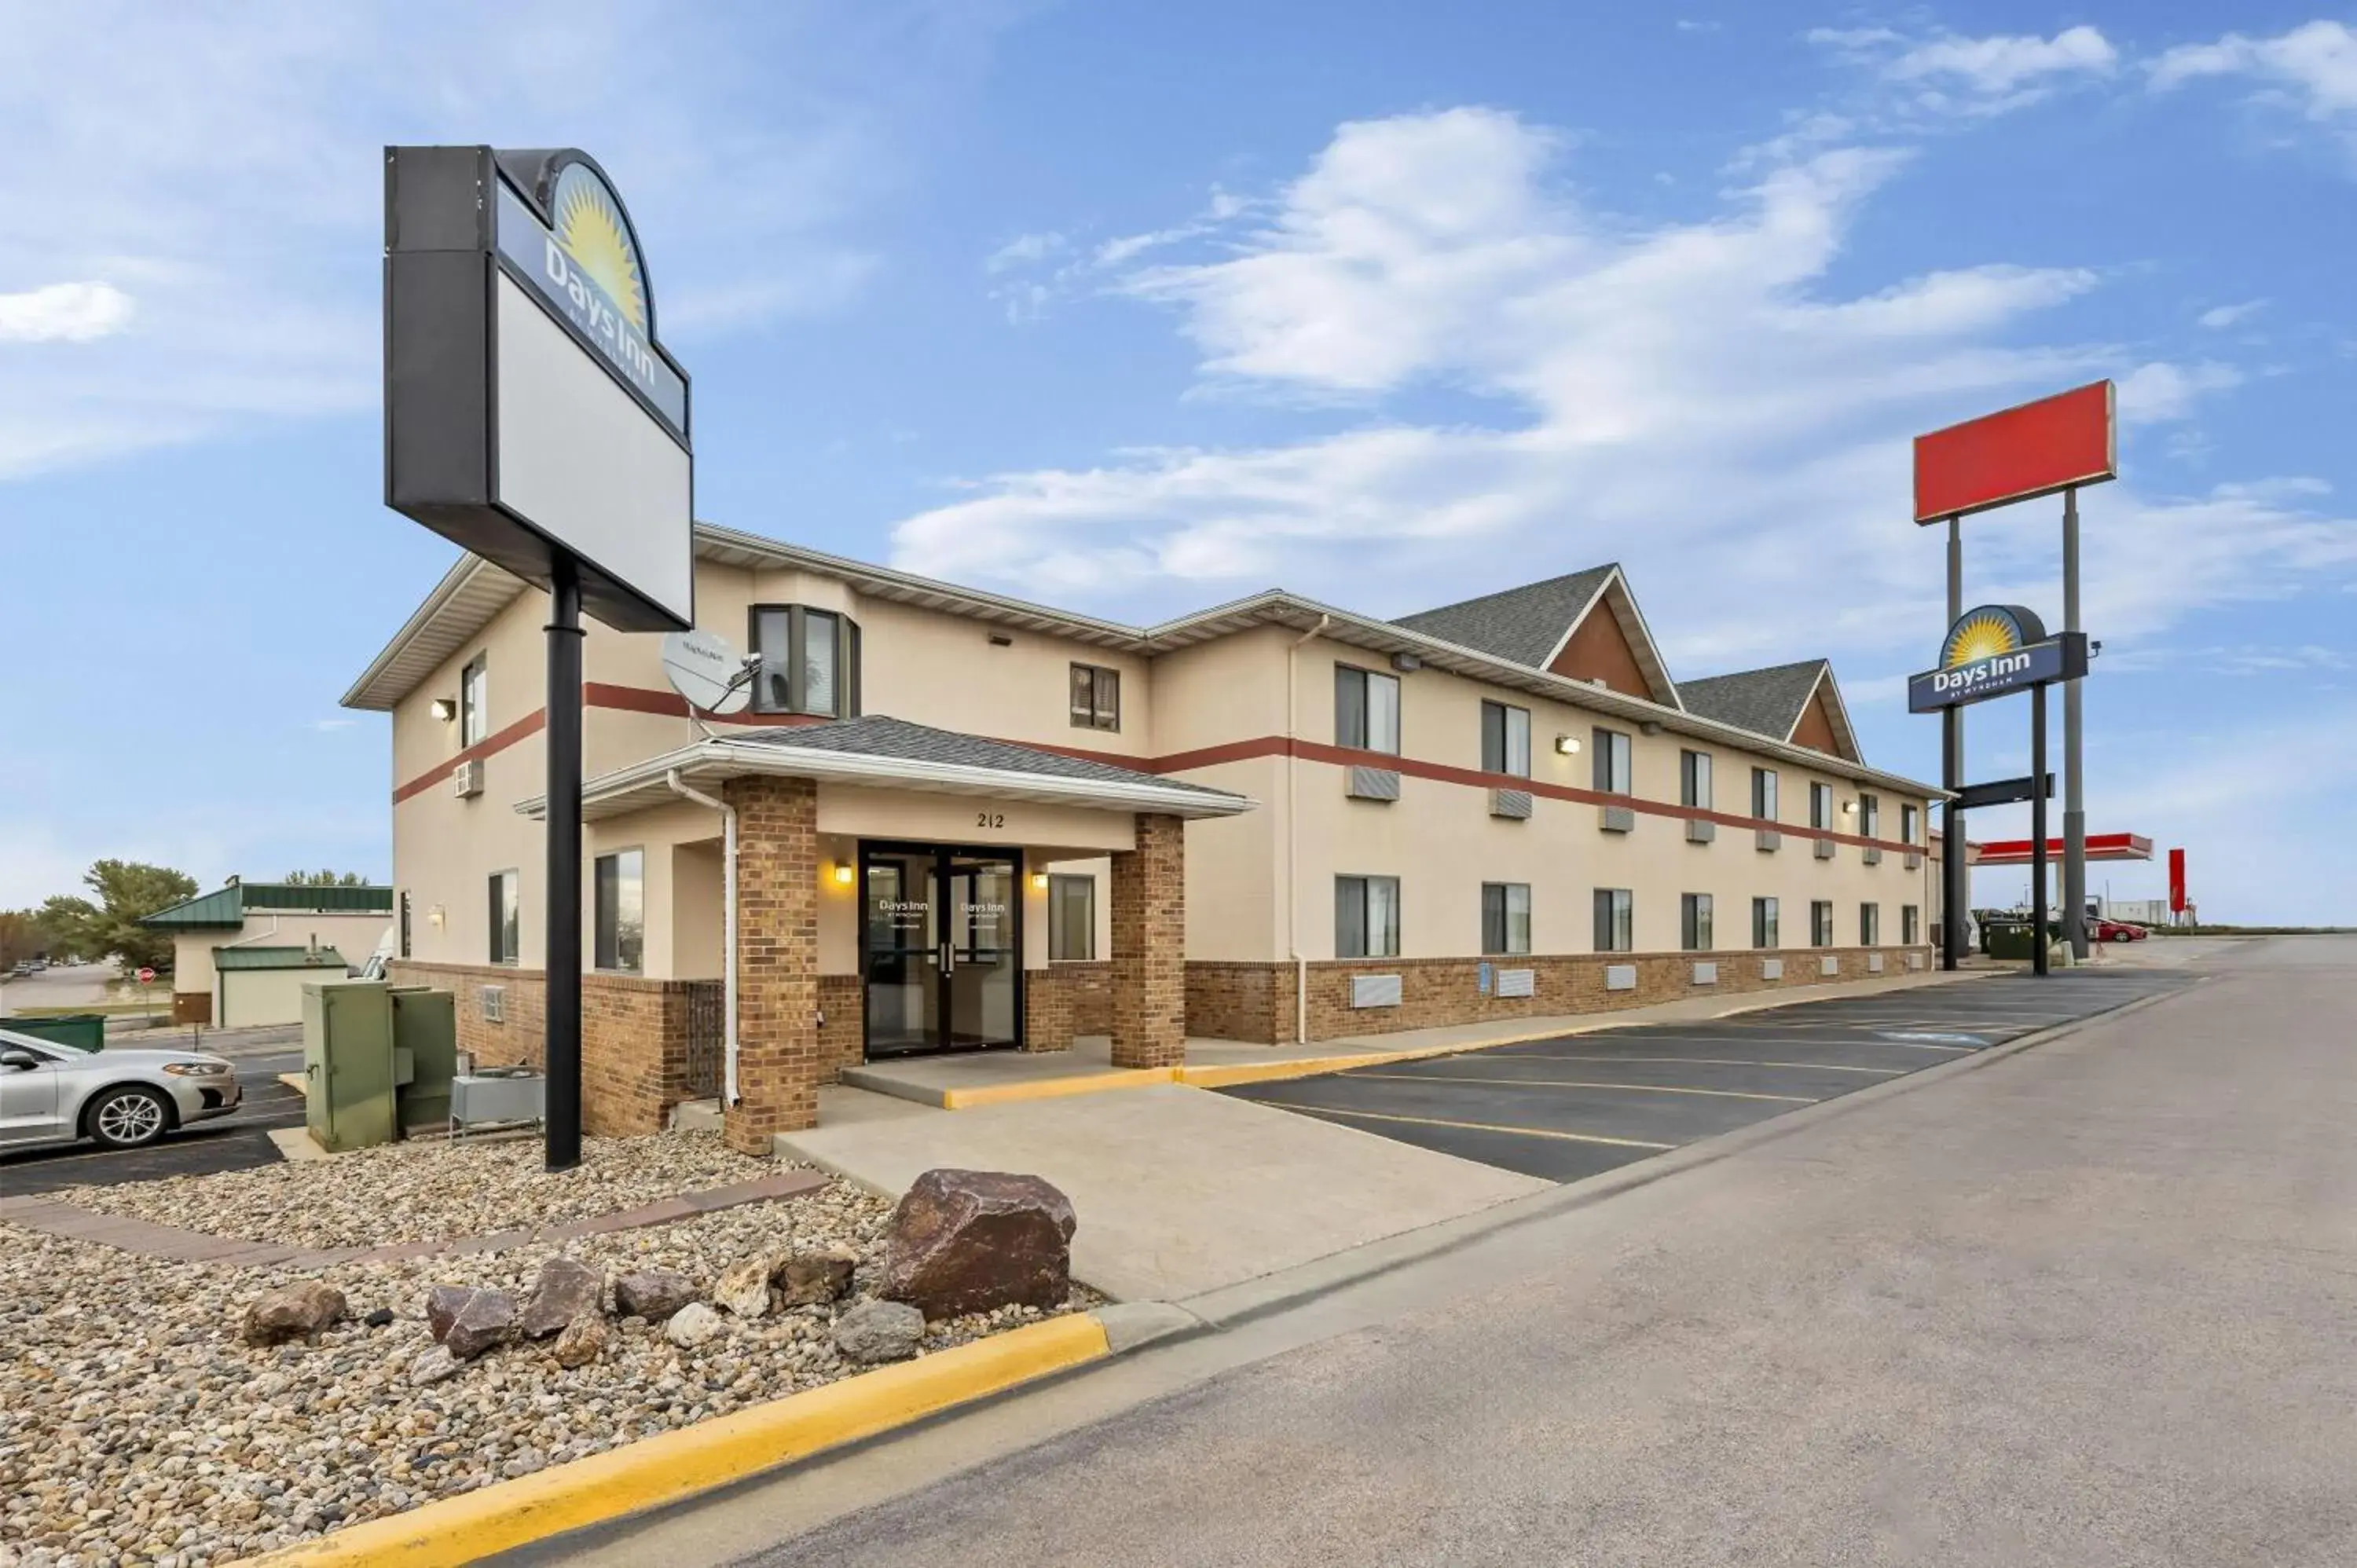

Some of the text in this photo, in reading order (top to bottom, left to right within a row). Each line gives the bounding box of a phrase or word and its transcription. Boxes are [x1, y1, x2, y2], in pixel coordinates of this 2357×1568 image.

[546, 237, 614, 339] Days
[618, 317, 655, 387] Inn
[1934, 653, 2031, 692] Days Inn
[977, 812, 1004, 829] 212
[879, 899, 929, 912] Days Inn
[959, 902, 1005, 913] Days Inn
